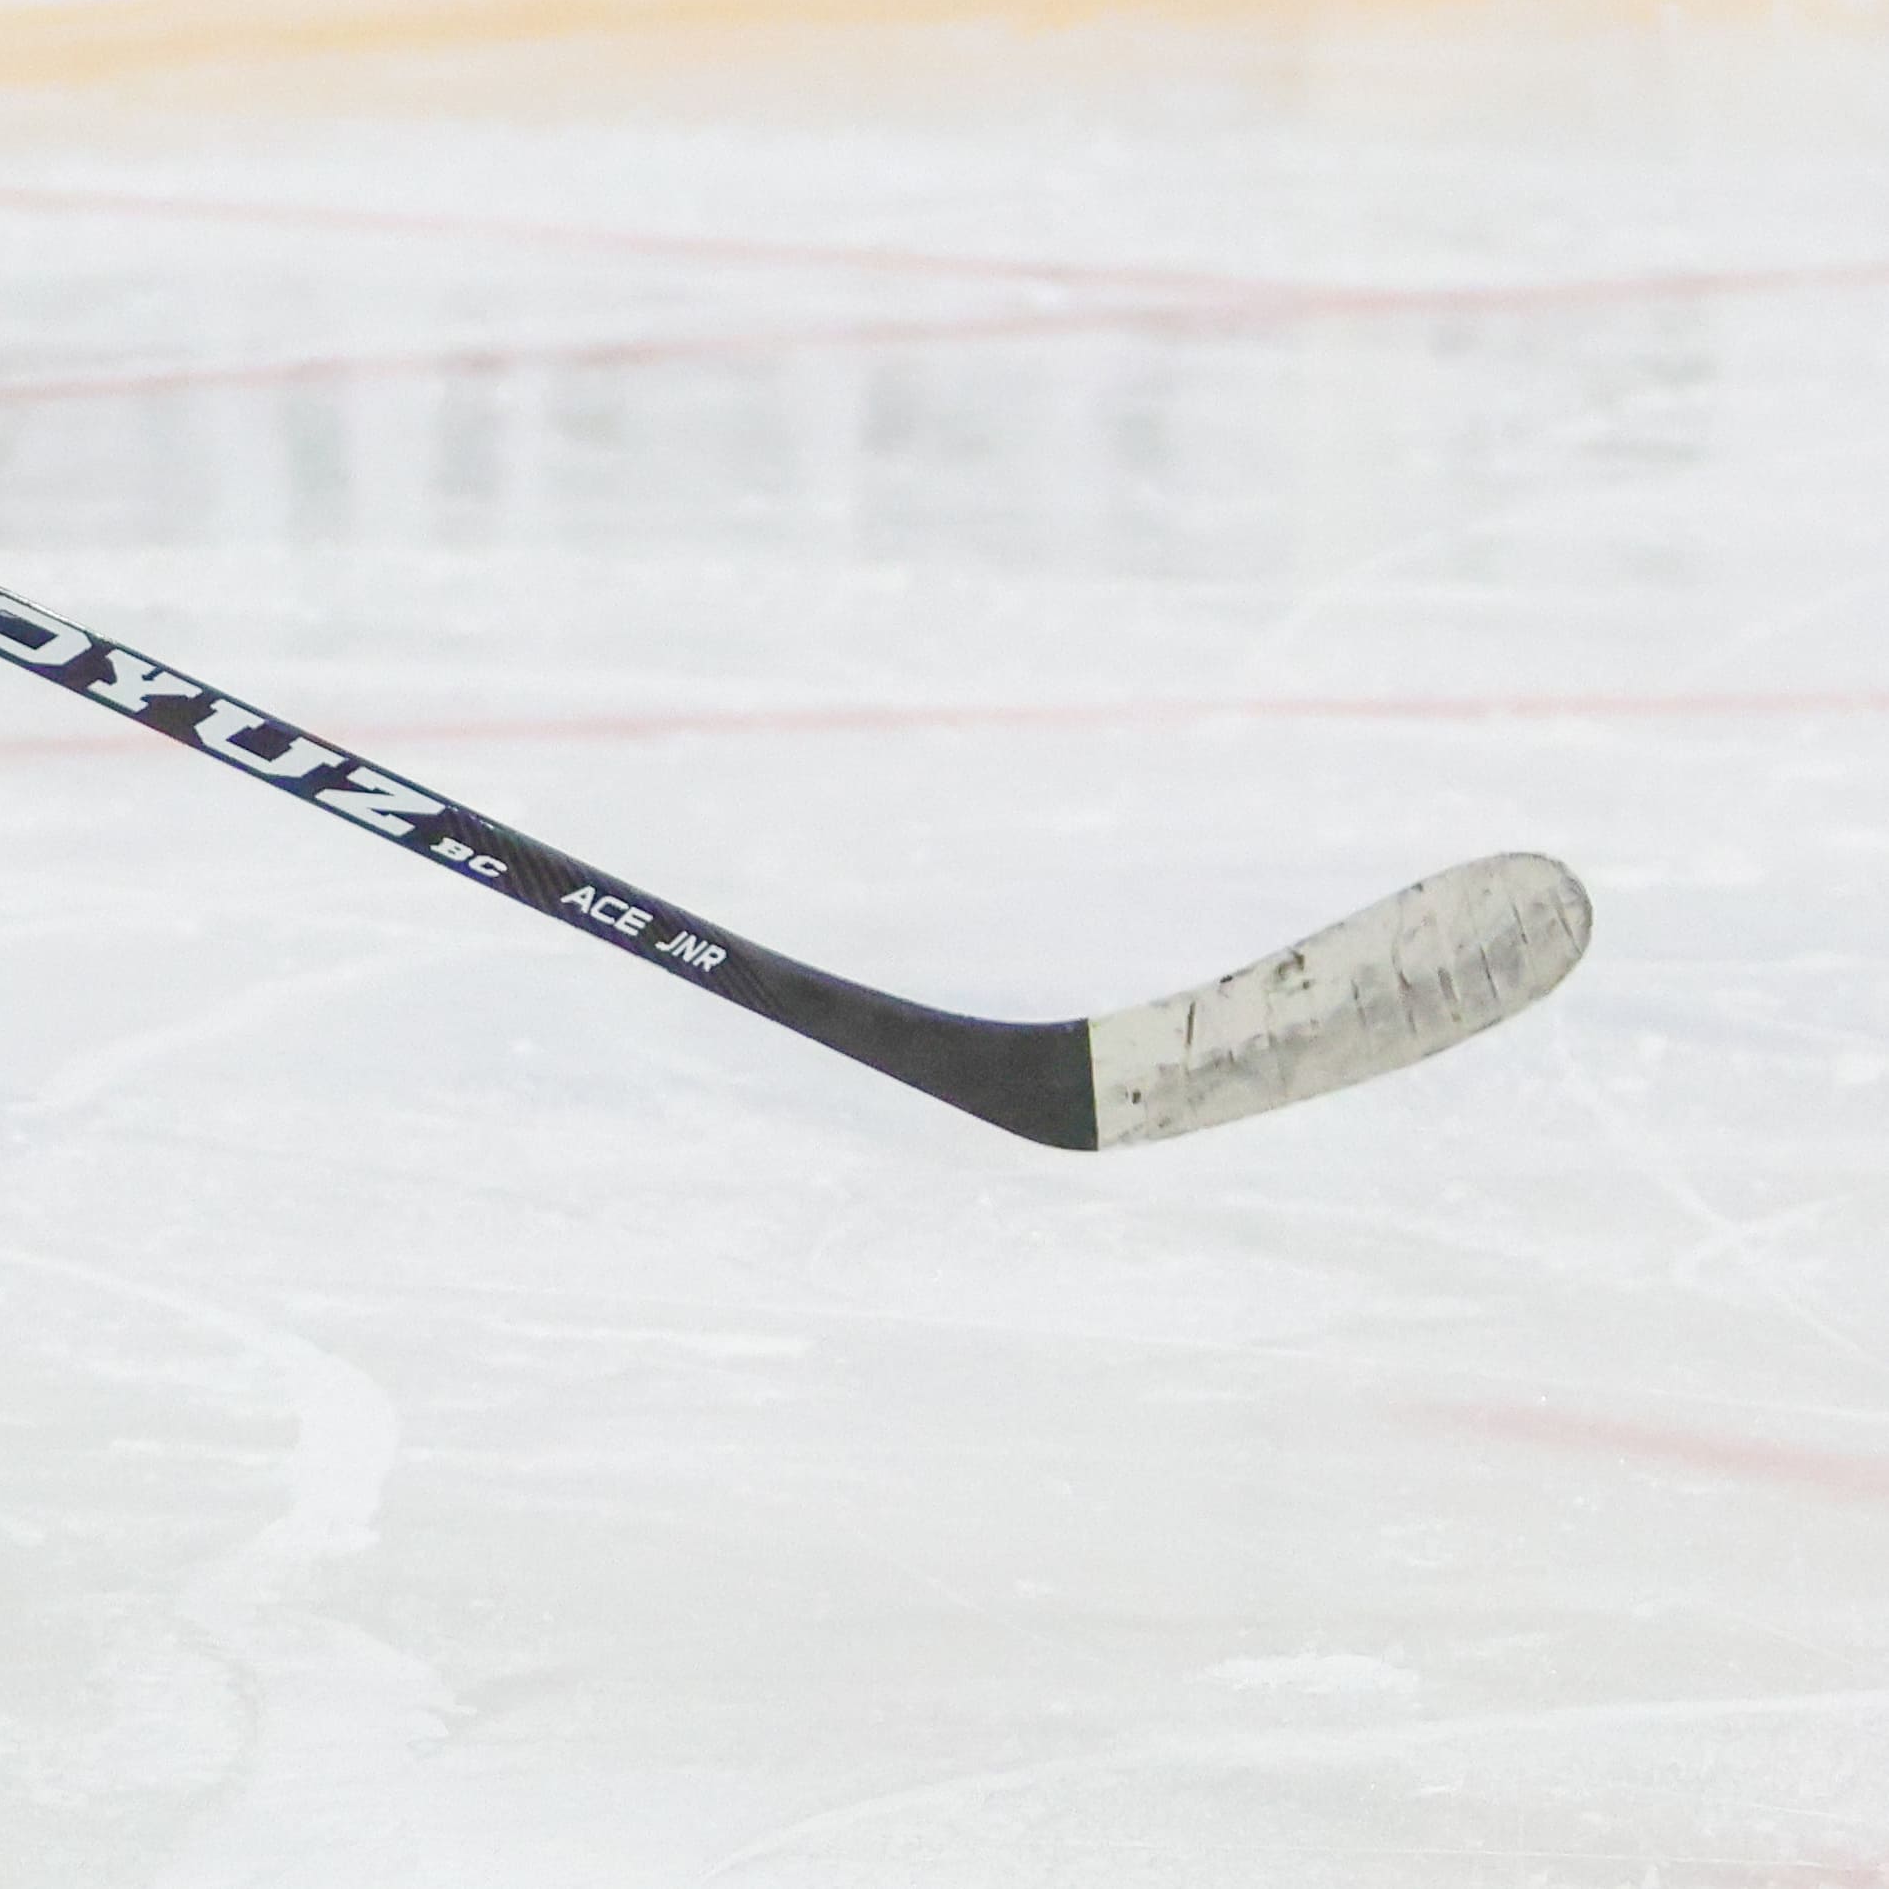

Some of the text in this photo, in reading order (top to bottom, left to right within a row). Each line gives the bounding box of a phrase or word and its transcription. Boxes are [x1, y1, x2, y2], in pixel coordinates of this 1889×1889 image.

[429, 836, 508, 877] BC
[561, 885, 727, 973] ACE JNR
